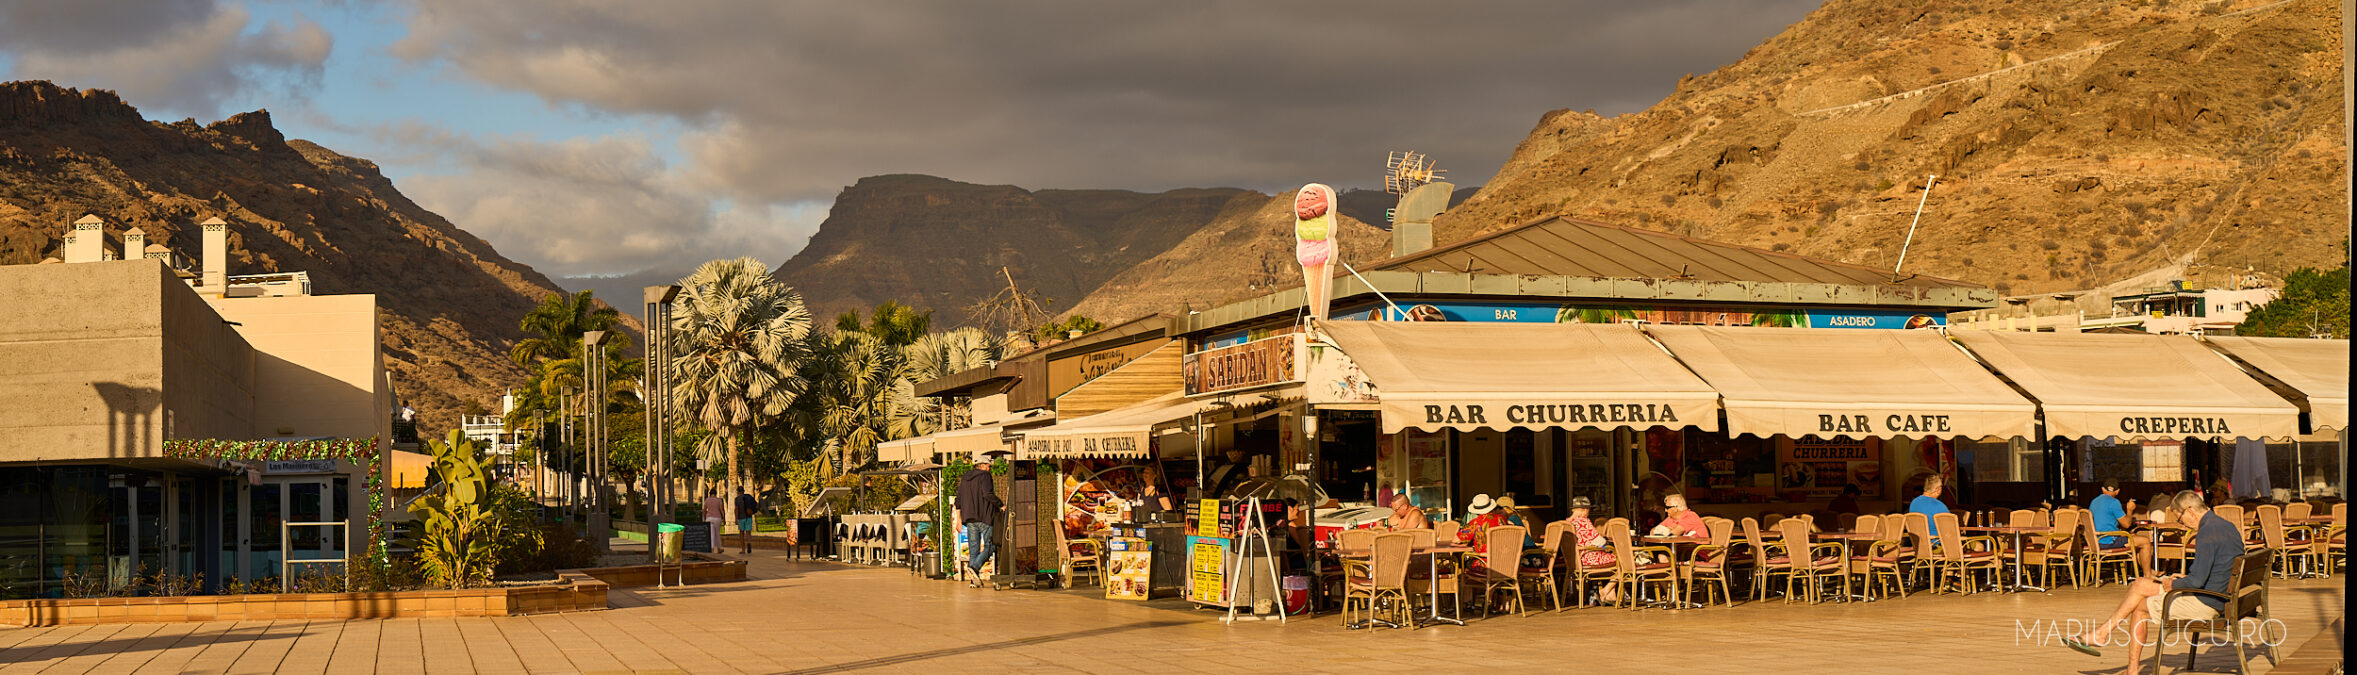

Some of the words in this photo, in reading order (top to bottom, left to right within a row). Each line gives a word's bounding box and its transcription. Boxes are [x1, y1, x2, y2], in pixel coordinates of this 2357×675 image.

[1495, 309, 1517, 320] BAR
[1829, 316, 1876, 327] ASADERO
[1208, 344, 1268, 389] SABIDÁN
[1424, 404, 1487, 424] BAR
[1506, 403, 1678, 423] CHURRERIA
[1818, 414, 1872, 433] BAR
[1886, 414, 1951, 433] CAFE
[2120, 417, 2231, 434] CREPERIA
[1053, 439, 1061, 452] DE
[1083, 438, 1097, 452] BAR
[1793, 447, 1869, 459] CHURRERIA
[1239, 501, 1283, 513] FMBÉ
